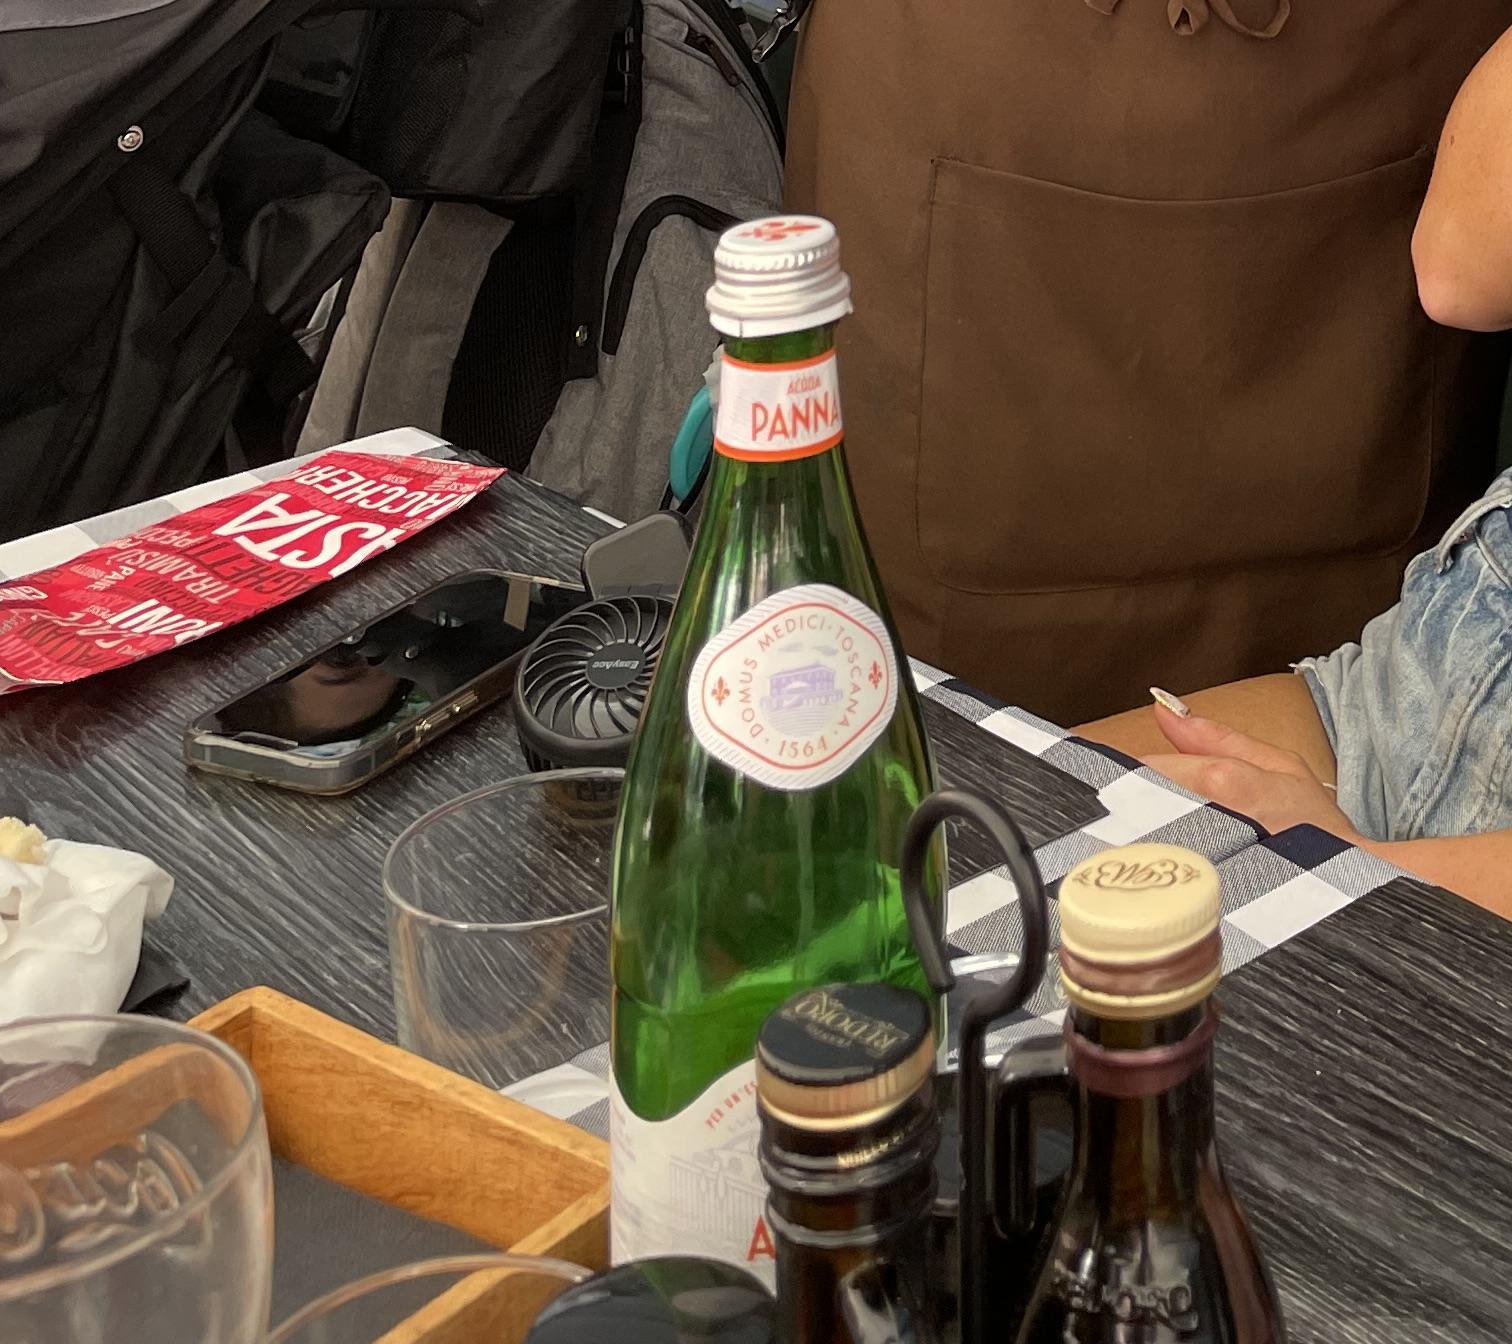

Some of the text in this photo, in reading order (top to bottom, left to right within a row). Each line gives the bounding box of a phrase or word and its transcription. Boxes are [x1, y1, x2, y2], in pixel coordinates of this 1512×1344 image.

[751, 389, 839, 442] PANNA
[591, 659, 640, 670] EasyAcc
[738, 614, 862, 738] DOMUS MEDICI TOSCANA
[778, 735, 828, 758] 1564
